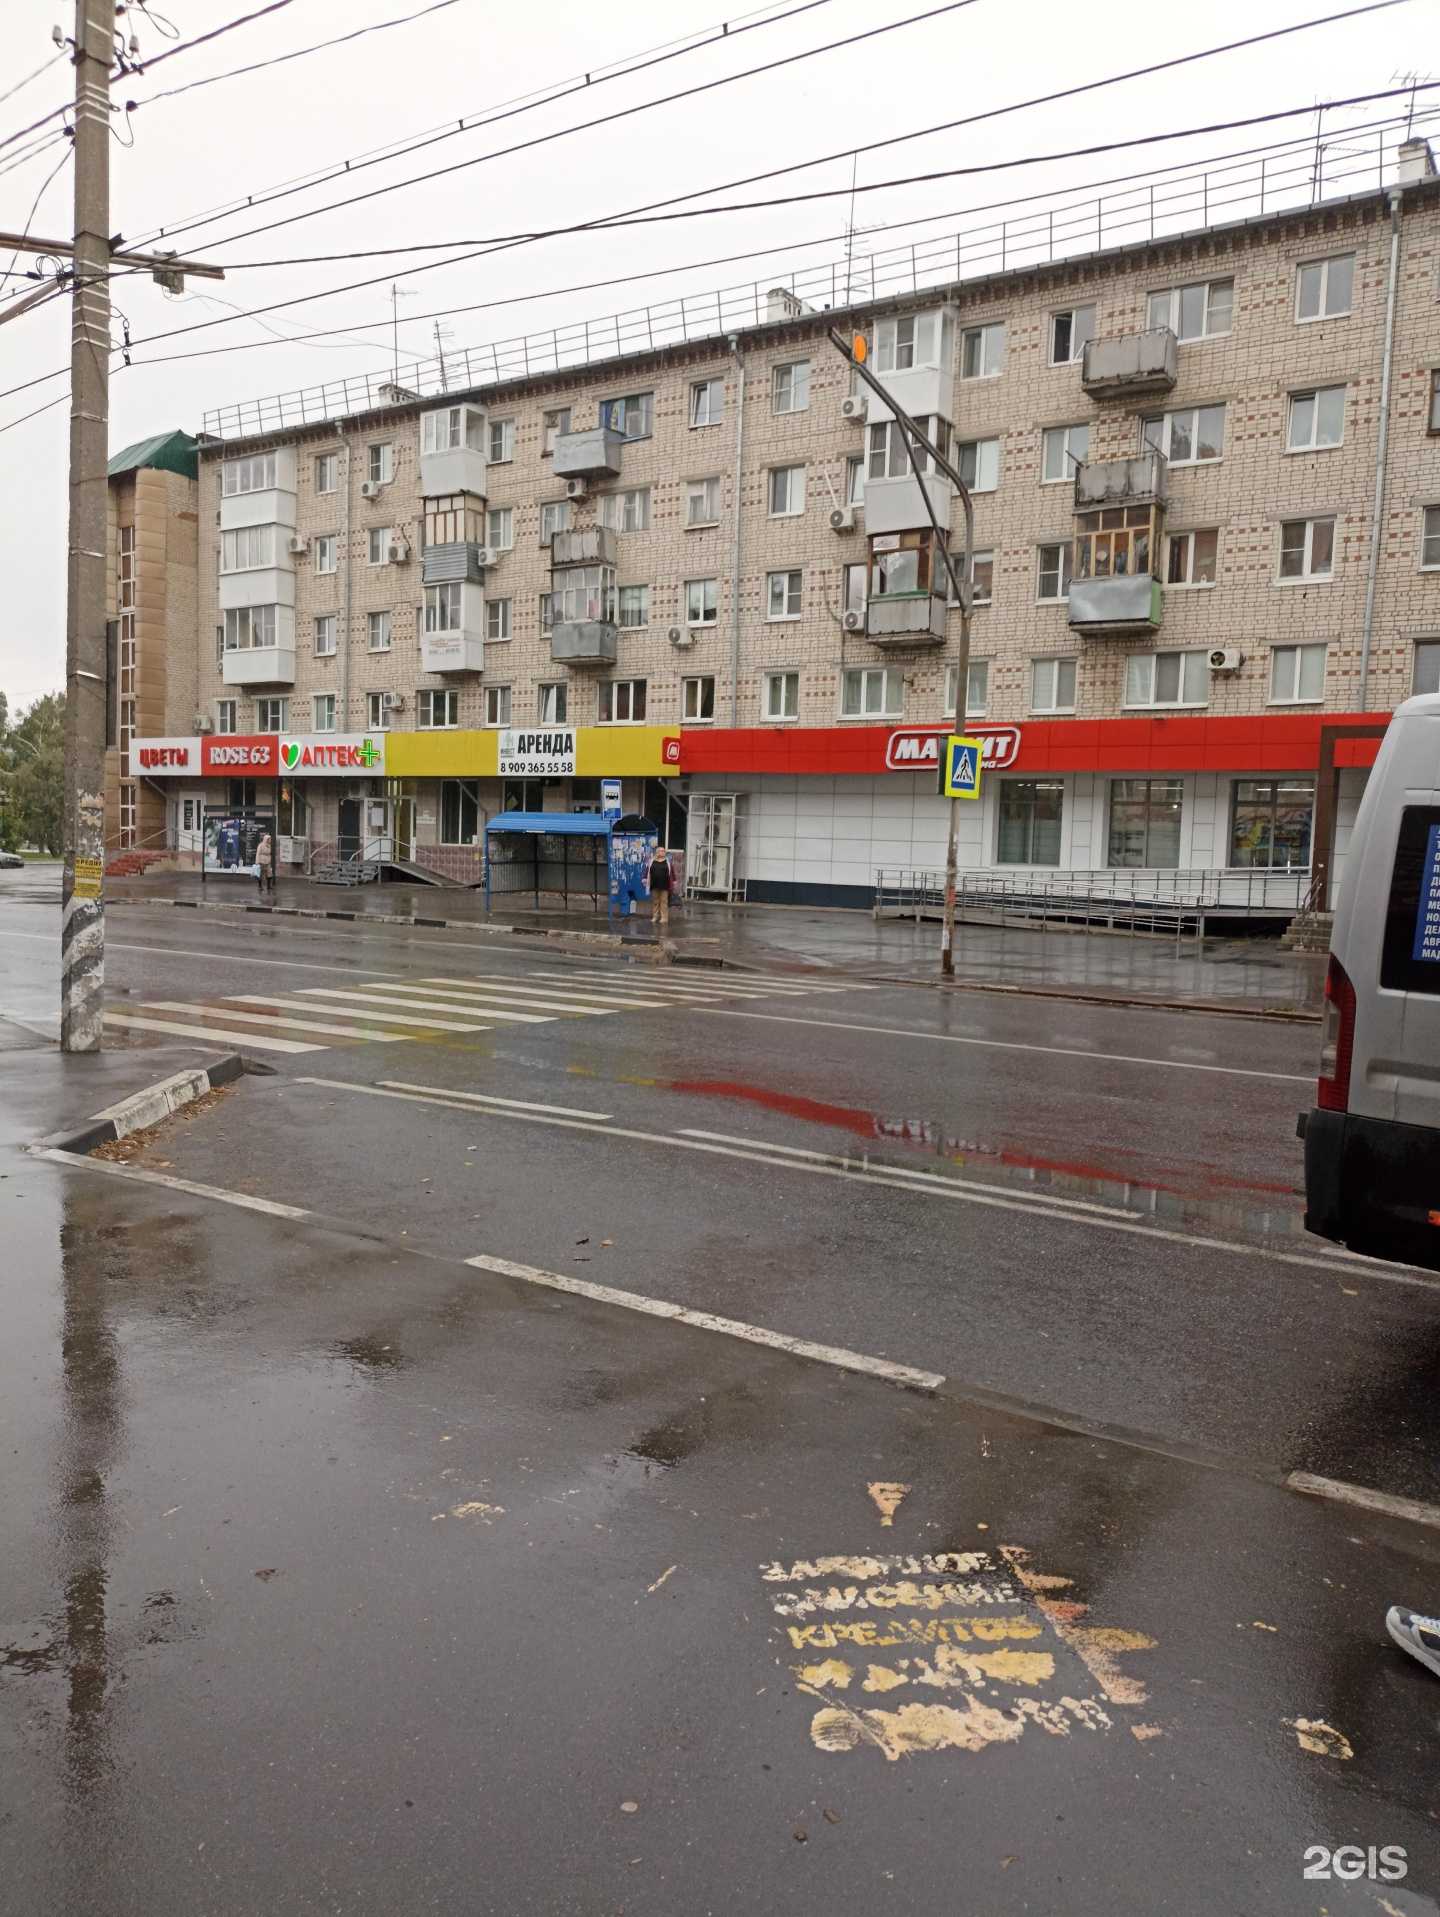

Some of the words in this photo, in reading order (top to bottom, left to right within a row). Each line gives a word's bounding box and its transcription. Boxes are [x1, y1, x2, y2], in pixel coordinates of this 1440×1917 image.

[210, 747, 249, 765] ROSE
[250, 745, 271, 765] 63
[517, 733, 573, 757] АРЕНДА
[894, 736, 1012, 760] МАИТ
[139, 748, 189, 769] ЦВЕТЫ
[301, 745, 381, 768] АПТЕК
[501, 763, 506, 773] 8
[508, 762, 526, 773] 909
[527, 762, 545, 773] 365
[547, 762, 559, 773] 55
[560, 762, 573, 773] 58
